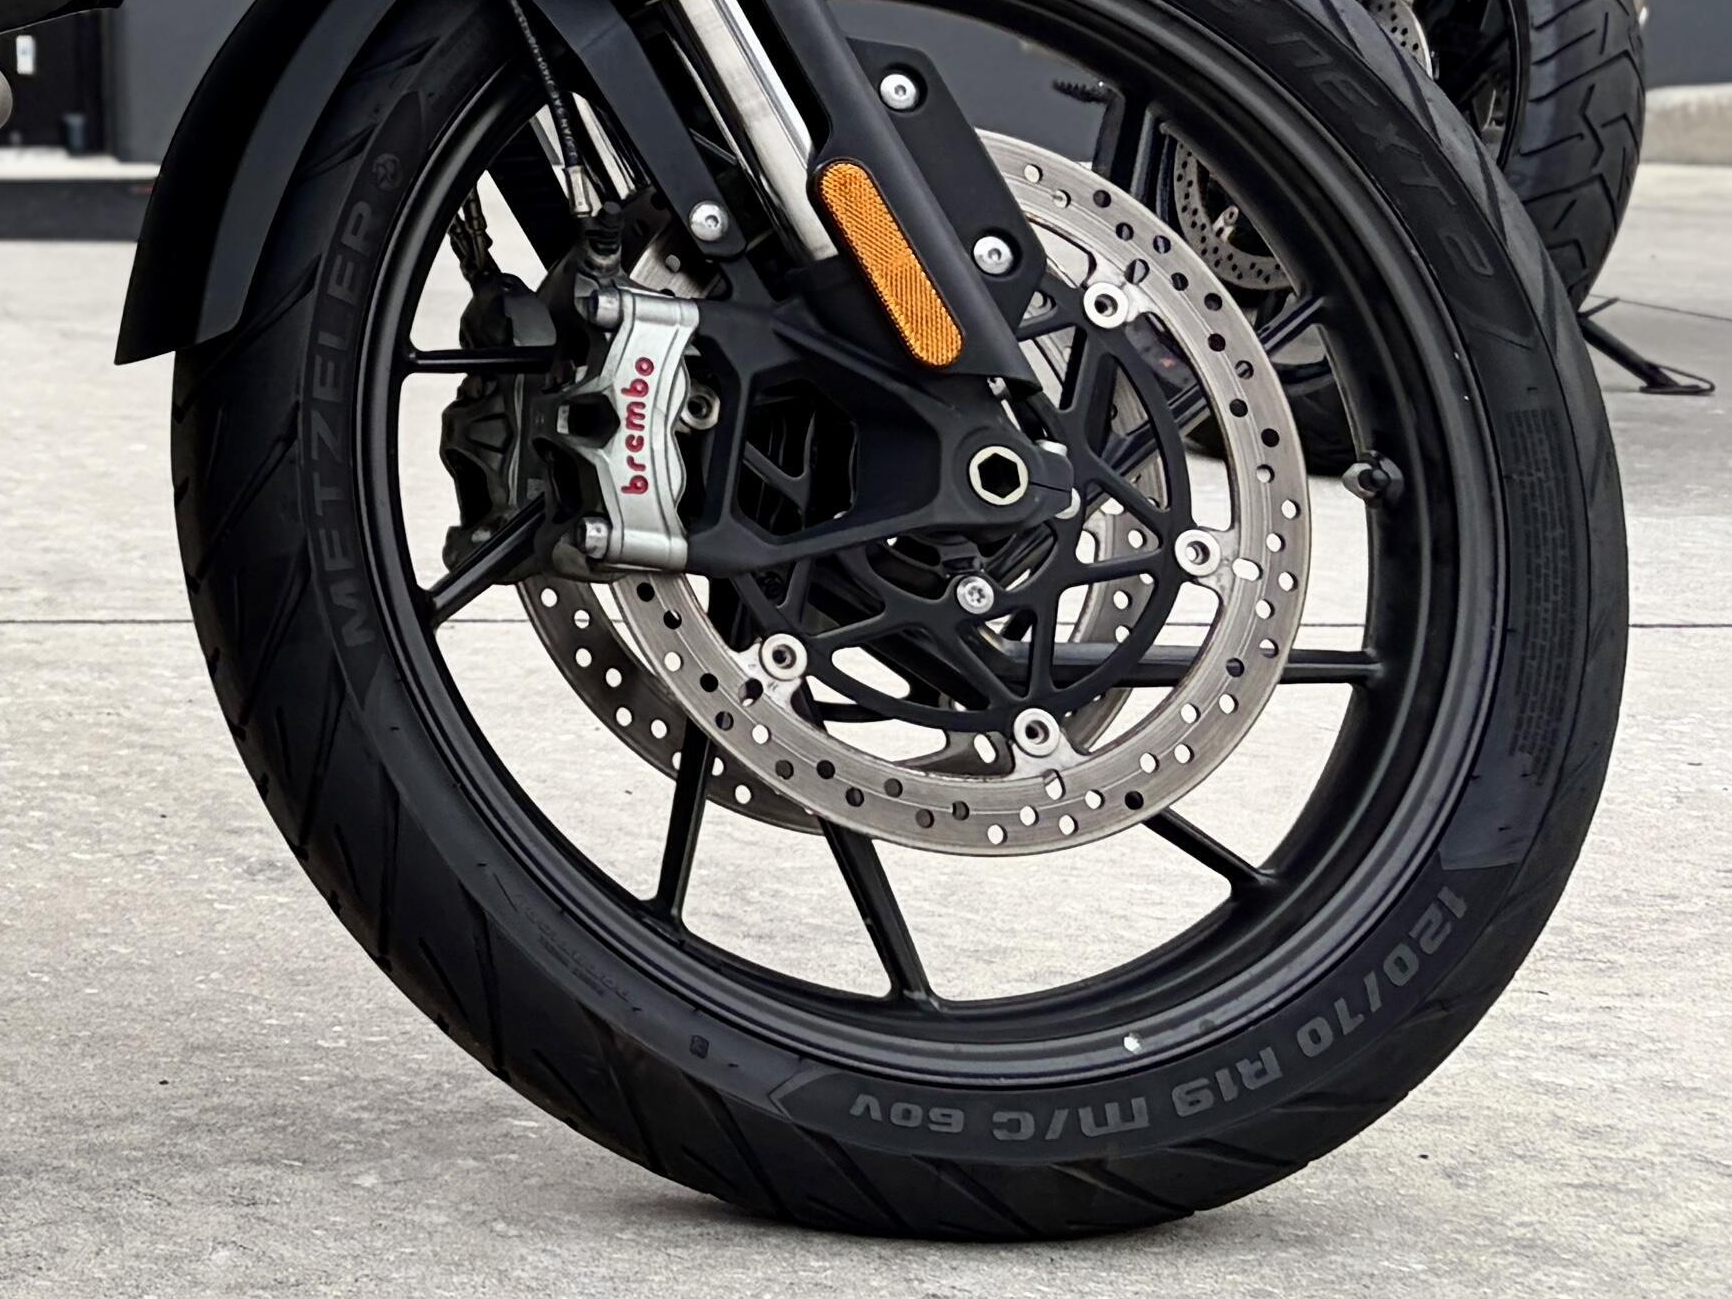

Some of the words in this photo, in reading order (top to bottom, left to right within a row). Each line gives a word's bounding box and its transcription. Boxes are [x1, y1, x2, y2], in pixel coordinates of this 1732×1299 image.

[311, 200, 376, 647] METZELER
[621, 357, 655, 495] brembo
[1296, 885, 1468, 1058] 120/70
[991, 1096, 1151, 1142] M/C
[1170, 1046, 1286, 1119] R19
